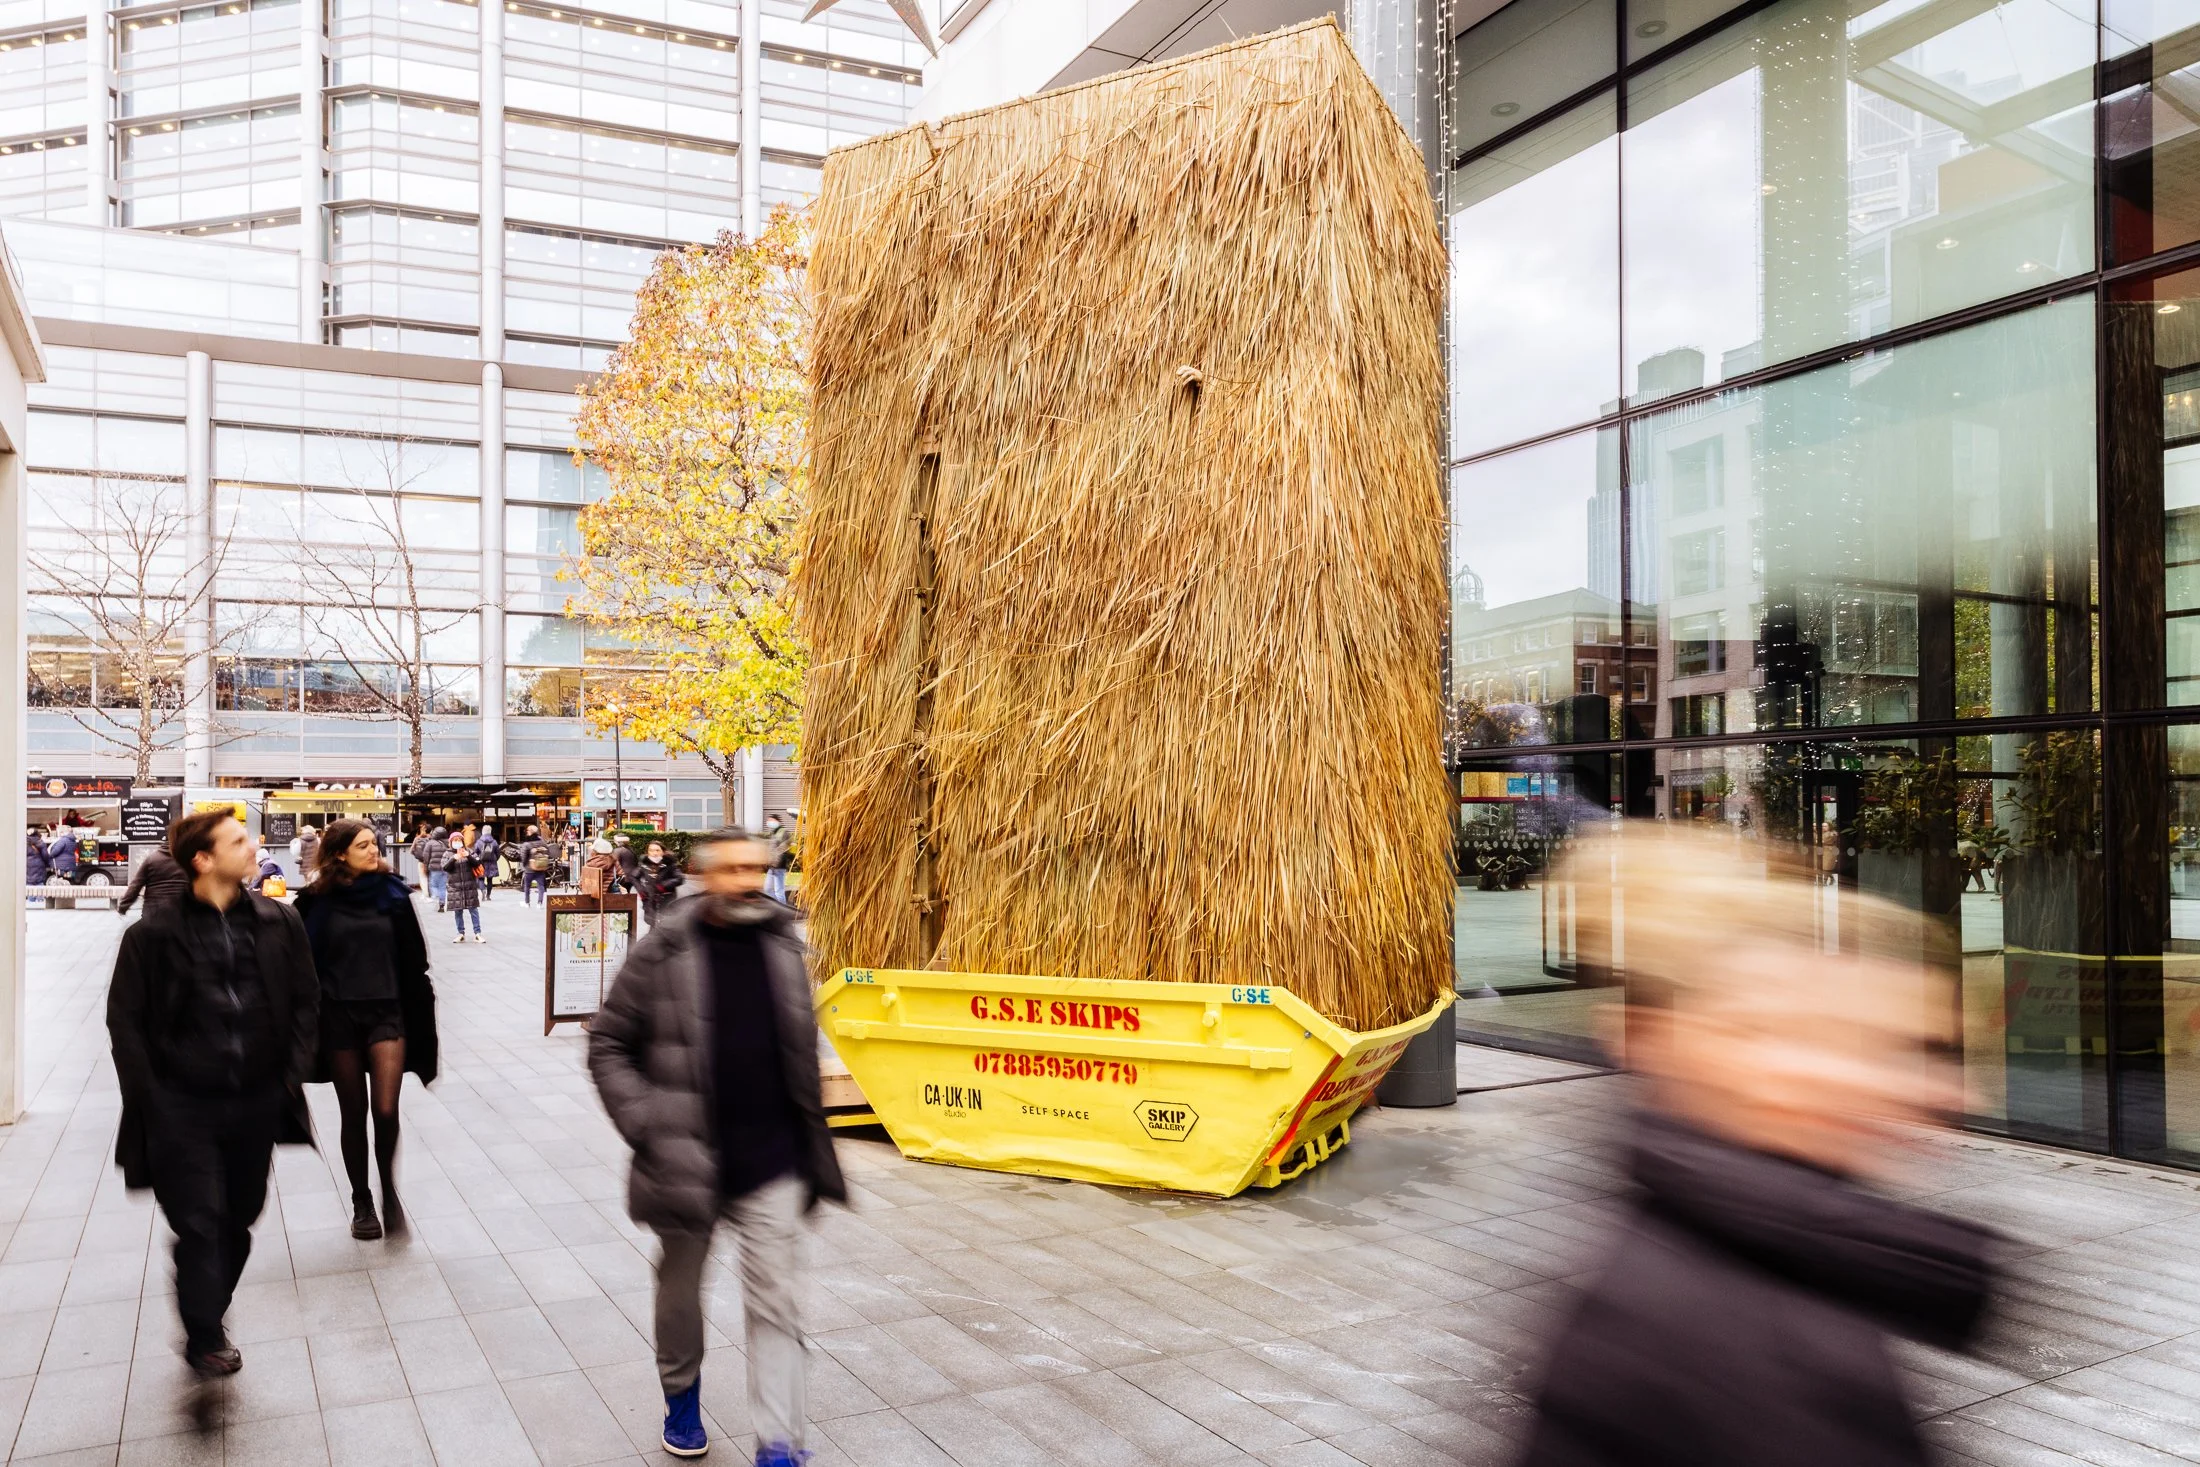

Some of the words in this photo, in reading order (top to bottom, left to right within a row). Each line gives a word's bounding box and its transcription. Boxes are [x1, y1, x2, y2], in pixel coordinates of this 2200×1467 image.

[593, 784, 657, 801] COSTA
[970, 995, 1043, 1024] G.S.E
[1050, 1001, 1141, 1032] SKIPS
[974, 1052, 1138, 1085] 07885950779
[1021, 1105, 1048, 1115] SELF
[1053, 1107, 1090, 1120] SPACE
[1148, 1108, 1186, 1124] SKIP
[1148, 1121, 1186, 1132] GALLERY
